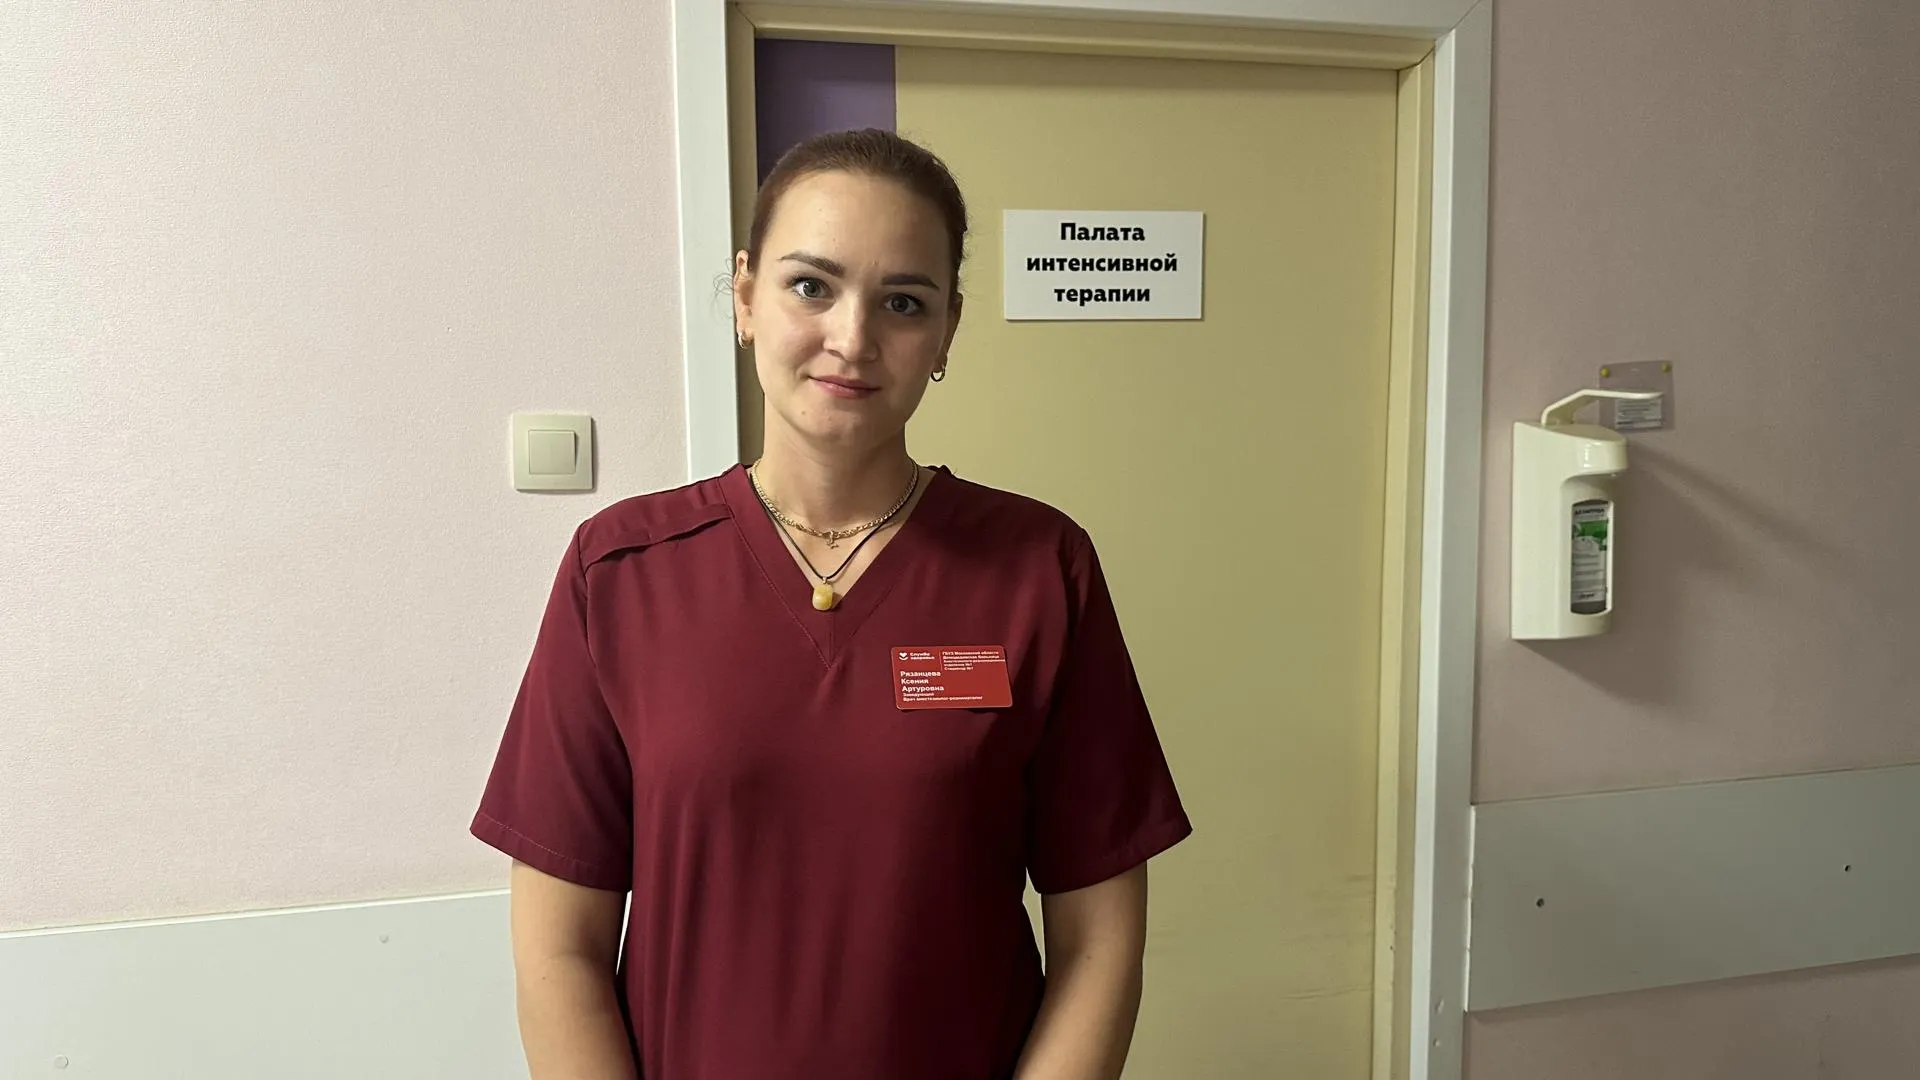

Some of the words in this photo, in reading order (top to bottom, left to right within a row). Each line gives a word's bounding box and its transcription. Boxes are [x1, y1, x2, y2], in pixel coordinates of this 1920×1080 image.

[1060, 222, 1146, 241] Палата
[1026, 253, 1178, 272] интенсивной
[1053, 288, 1151, 307] терапии
